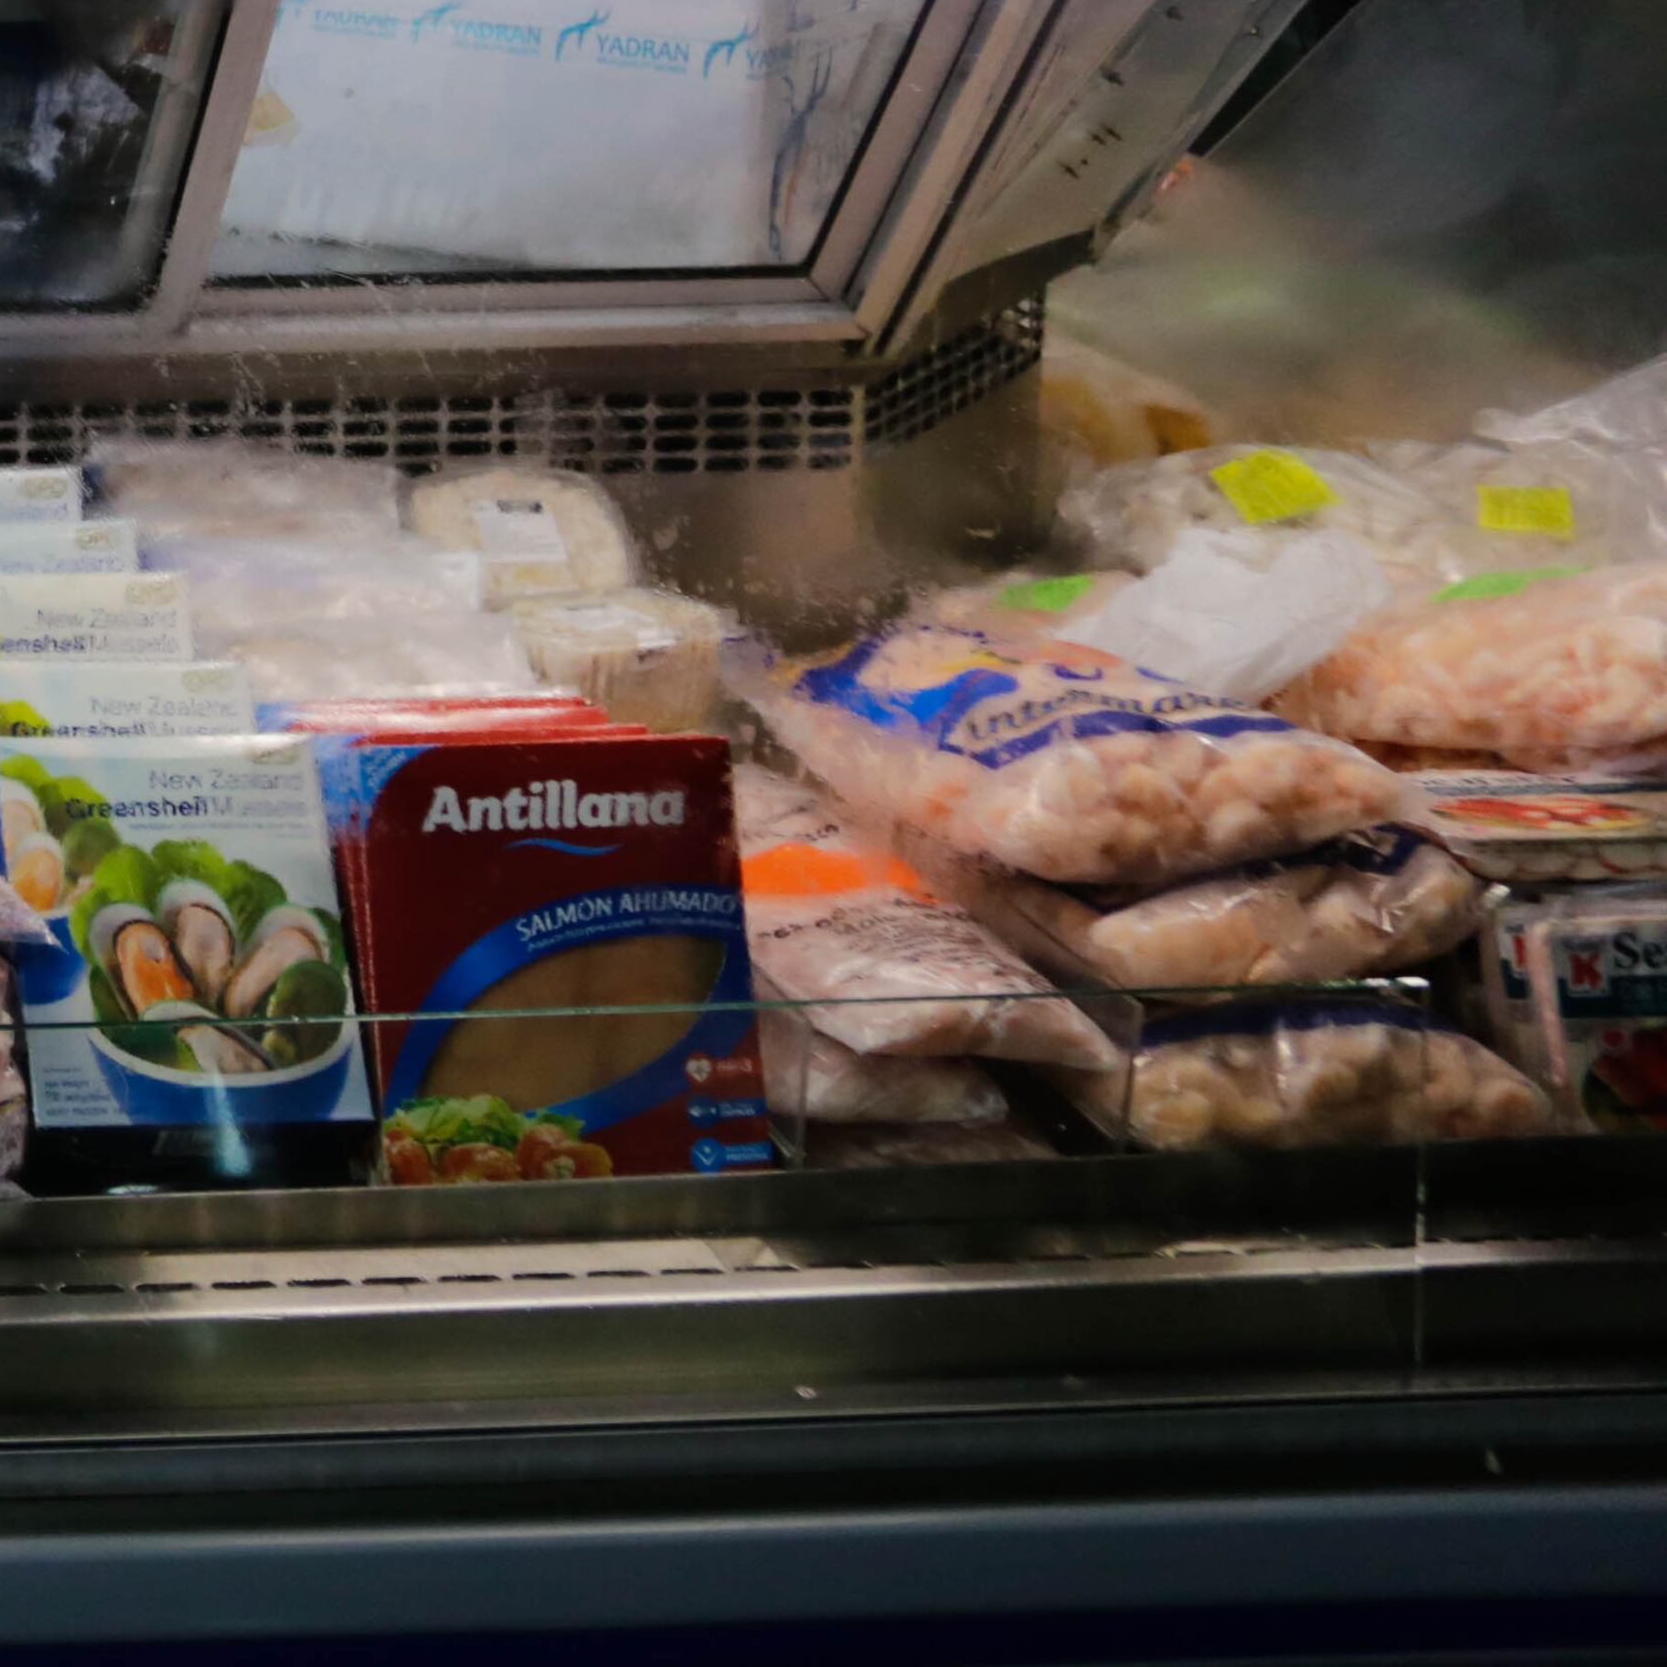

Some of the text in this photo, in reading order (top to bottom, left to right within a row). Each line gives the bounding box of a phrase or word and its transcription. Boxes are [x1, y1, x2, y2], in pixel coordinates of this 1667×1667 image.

[597, 34, 690, 63] YADRAN
[148, 768, 201, 790] New
[421, 780, 685, 833] Antillana
[619, 890, 737, 915] AHUMADO
